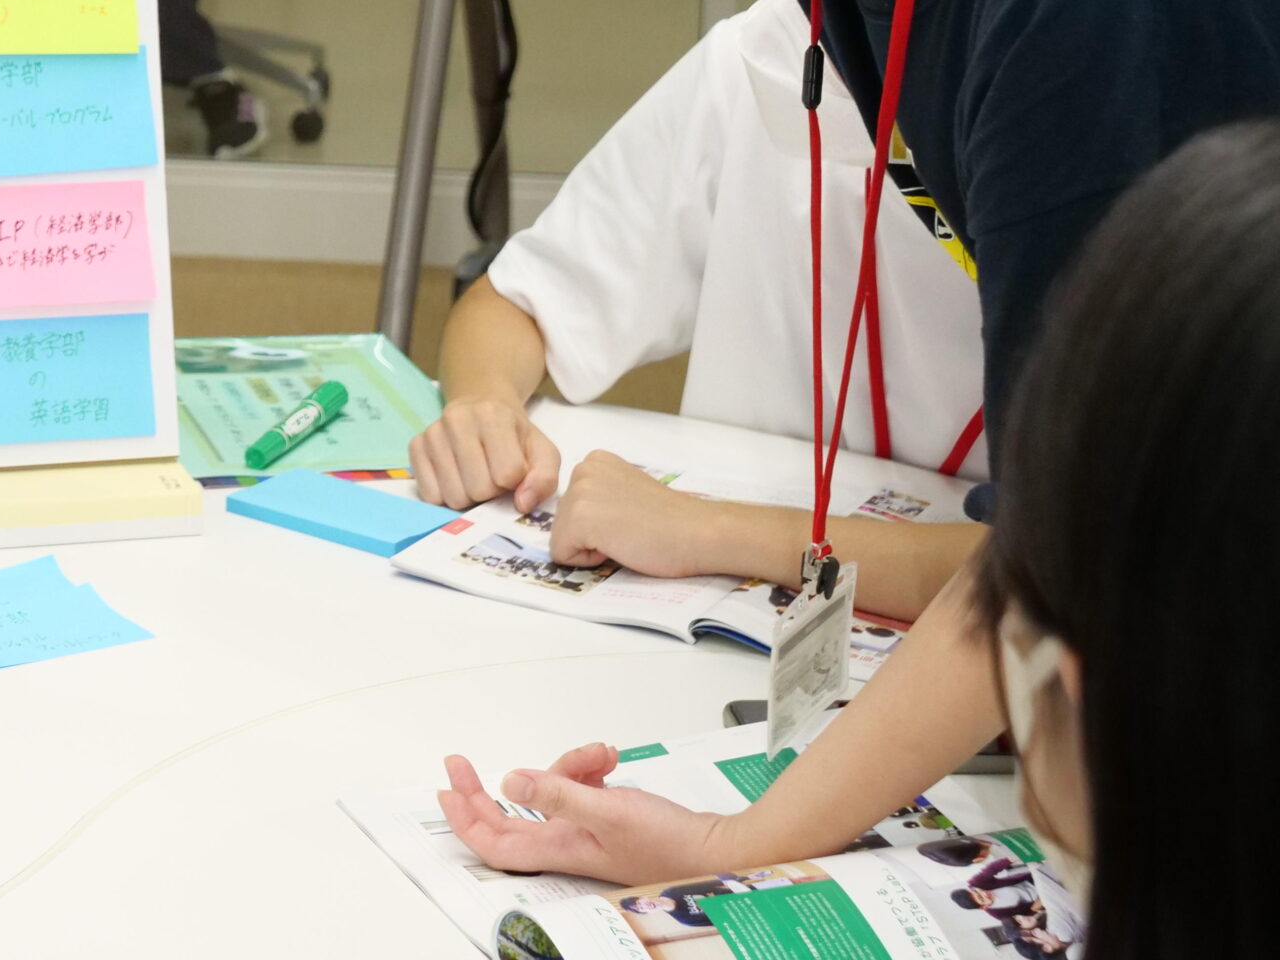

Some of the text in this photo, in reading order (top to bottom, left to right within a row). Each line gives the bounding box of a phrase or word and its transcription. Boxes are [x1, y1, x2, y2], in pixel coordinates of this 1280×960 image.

[28, 370, 47, 388] の
[28, 398, 110, 428] 英語学習
